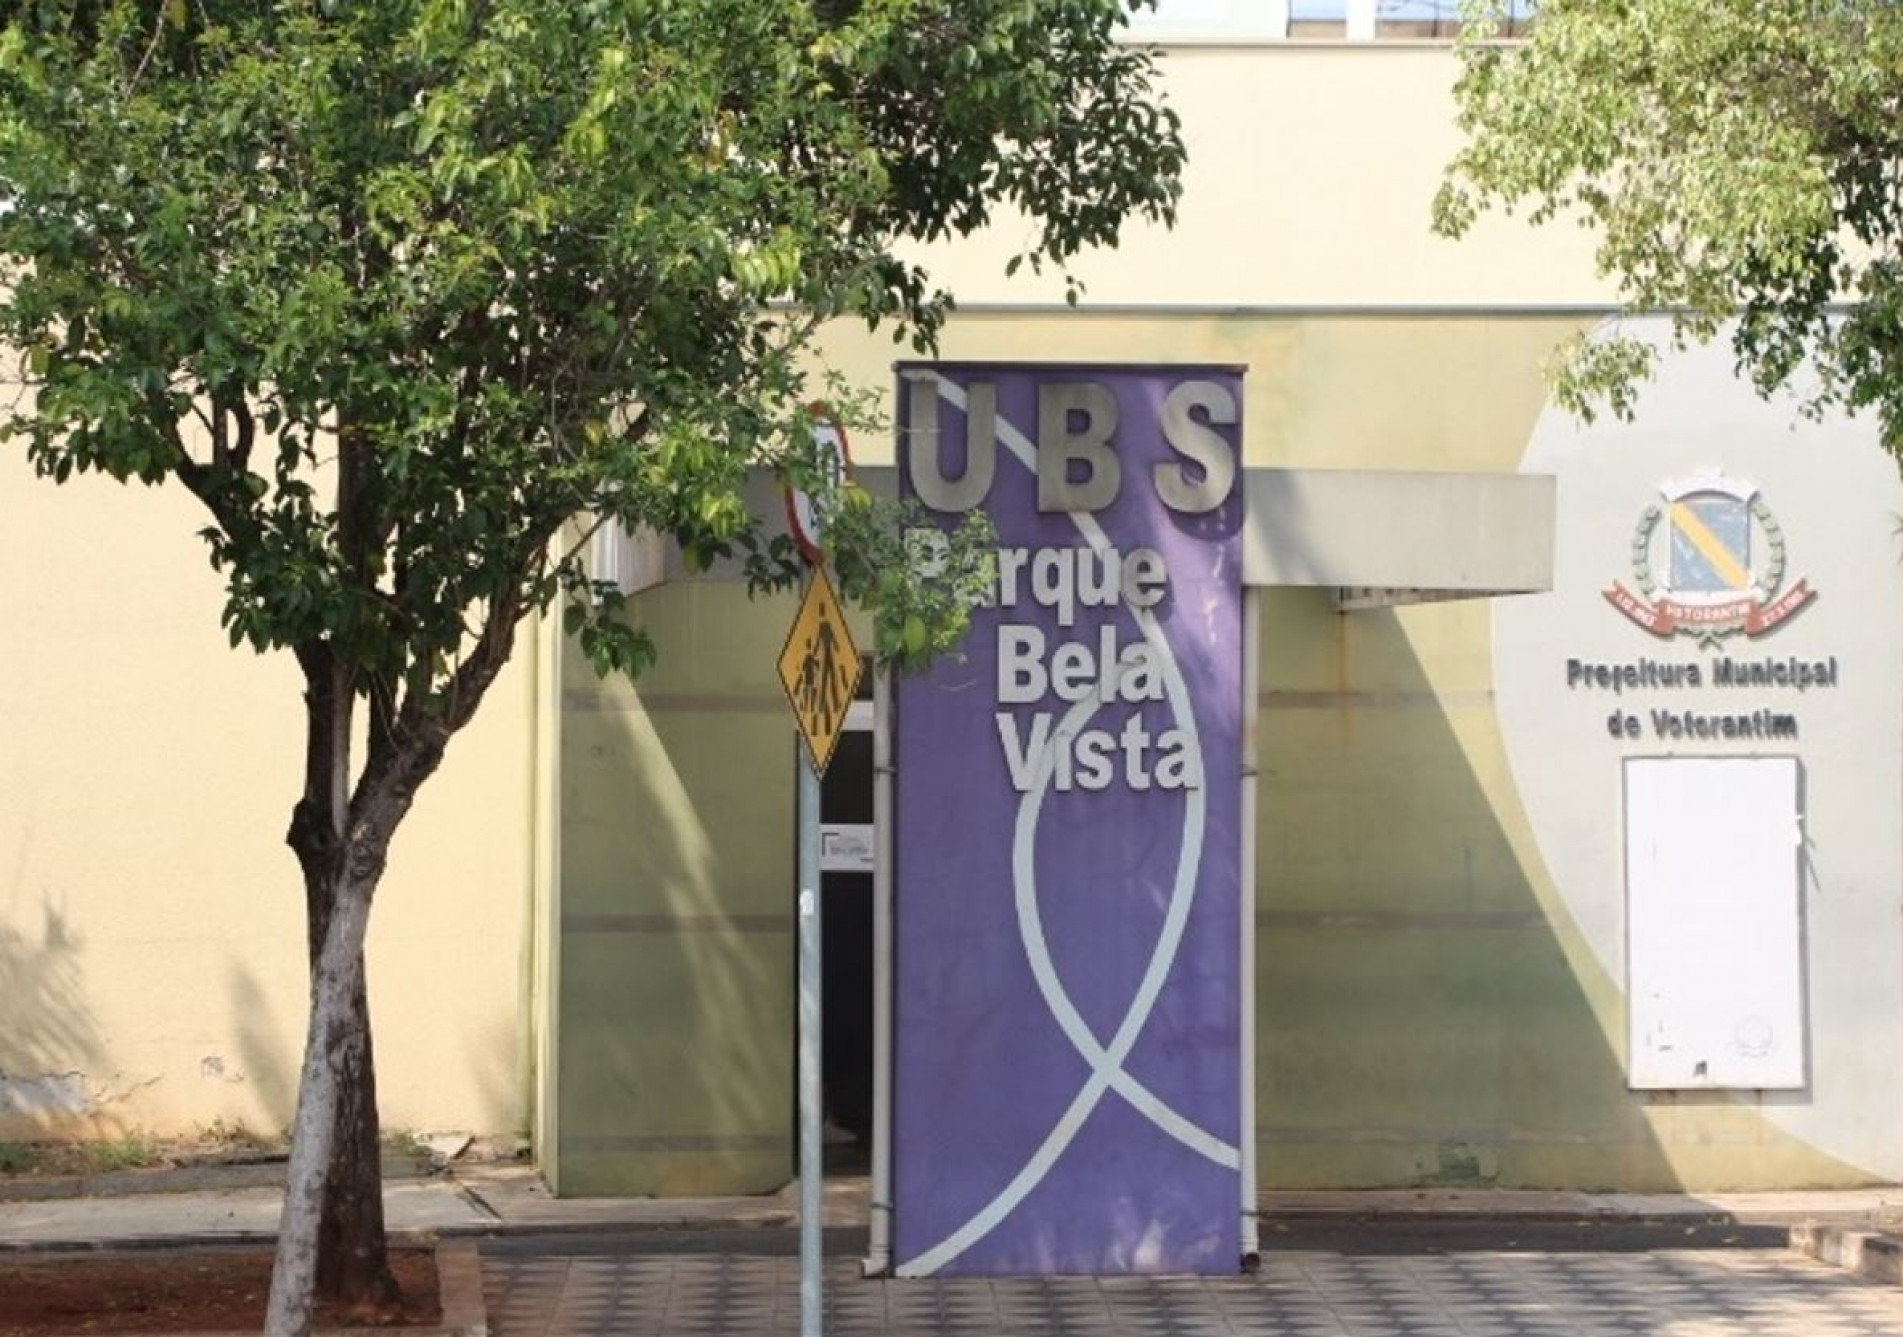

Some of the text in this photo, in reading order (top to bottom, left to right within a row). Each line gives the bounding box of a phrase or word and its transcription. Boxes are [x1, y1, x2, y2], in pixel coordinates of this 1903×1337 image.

[909, 380, 1237, 513] UBS
[997, 625, 1163, 703] Bela
[1566, 656, 1838, 694] Prefeitura Municipal
[996, 712, 1199, 792] Vista
[1607, 708, 1799, 740] de Votorantim
